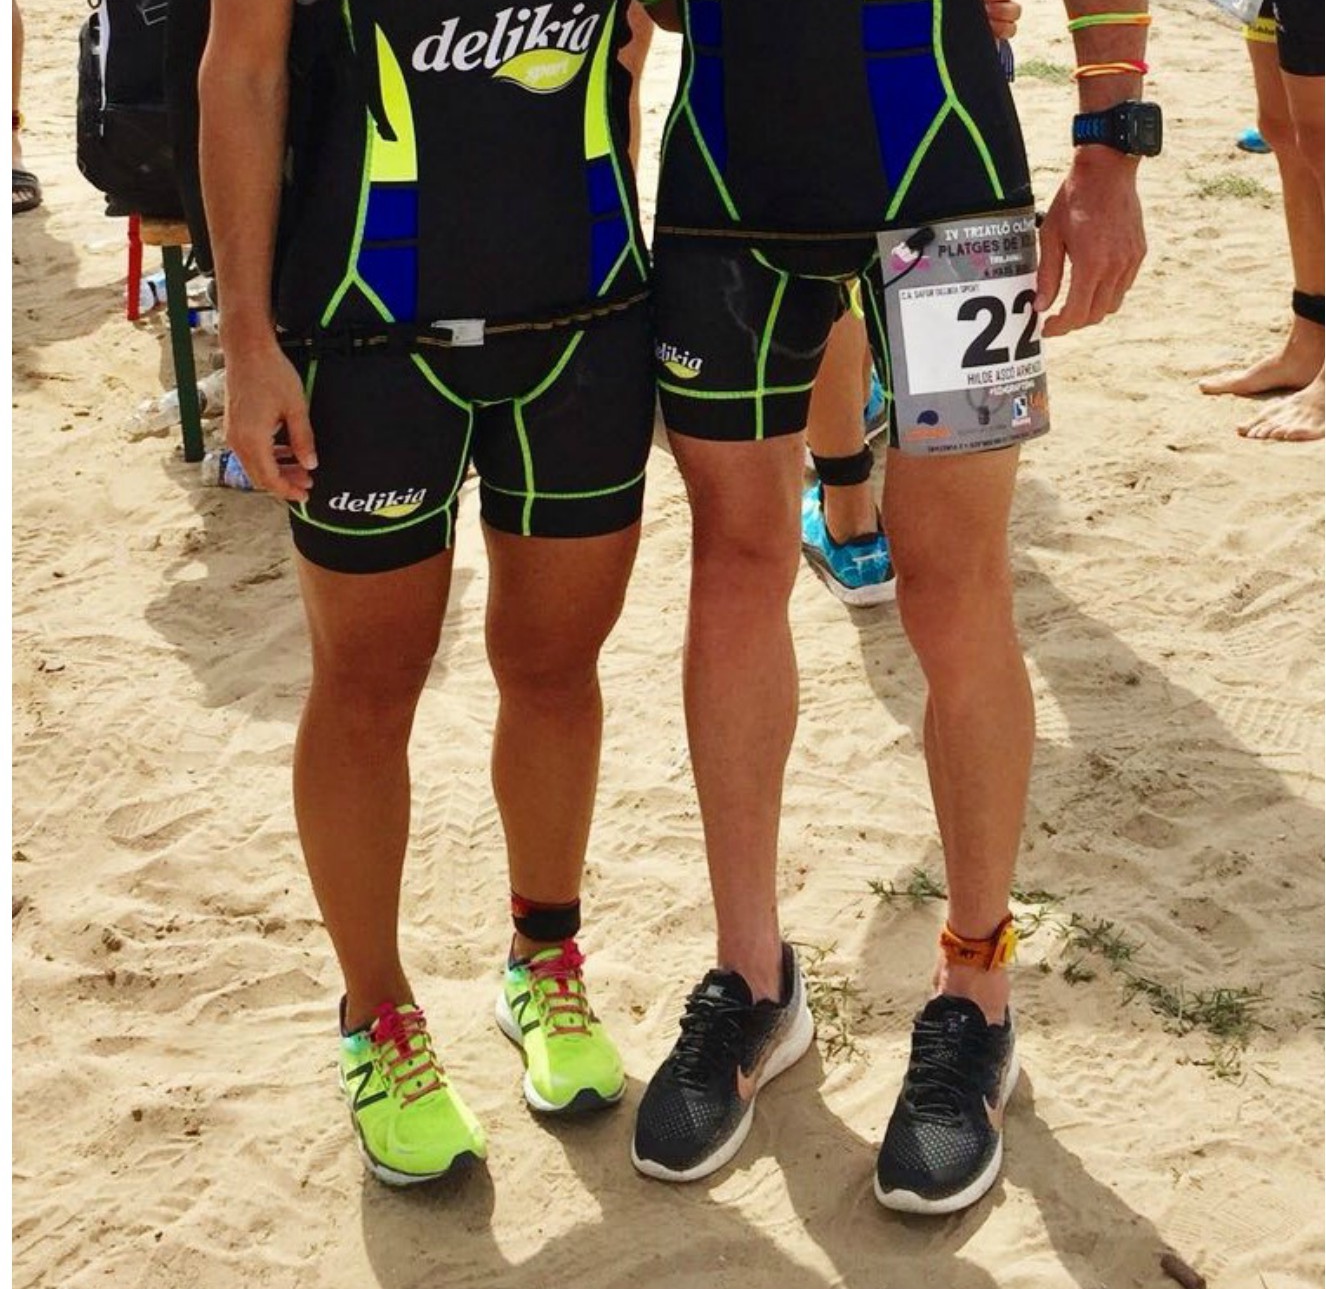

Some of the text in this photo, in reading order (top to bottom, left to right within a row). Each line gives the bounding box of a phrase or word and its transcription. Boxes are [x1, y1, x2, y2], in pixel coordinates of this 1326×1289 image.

[411, 2, 600, 72] delikia
[944, 228, 959, 241] IV
[963, 220, 1011, 239] TRIATLÓ
[938, 240, 1000, 259] PLATGES
[967, 370, 993, 386] HILDE
[328, 488, 427, 513] delikia
